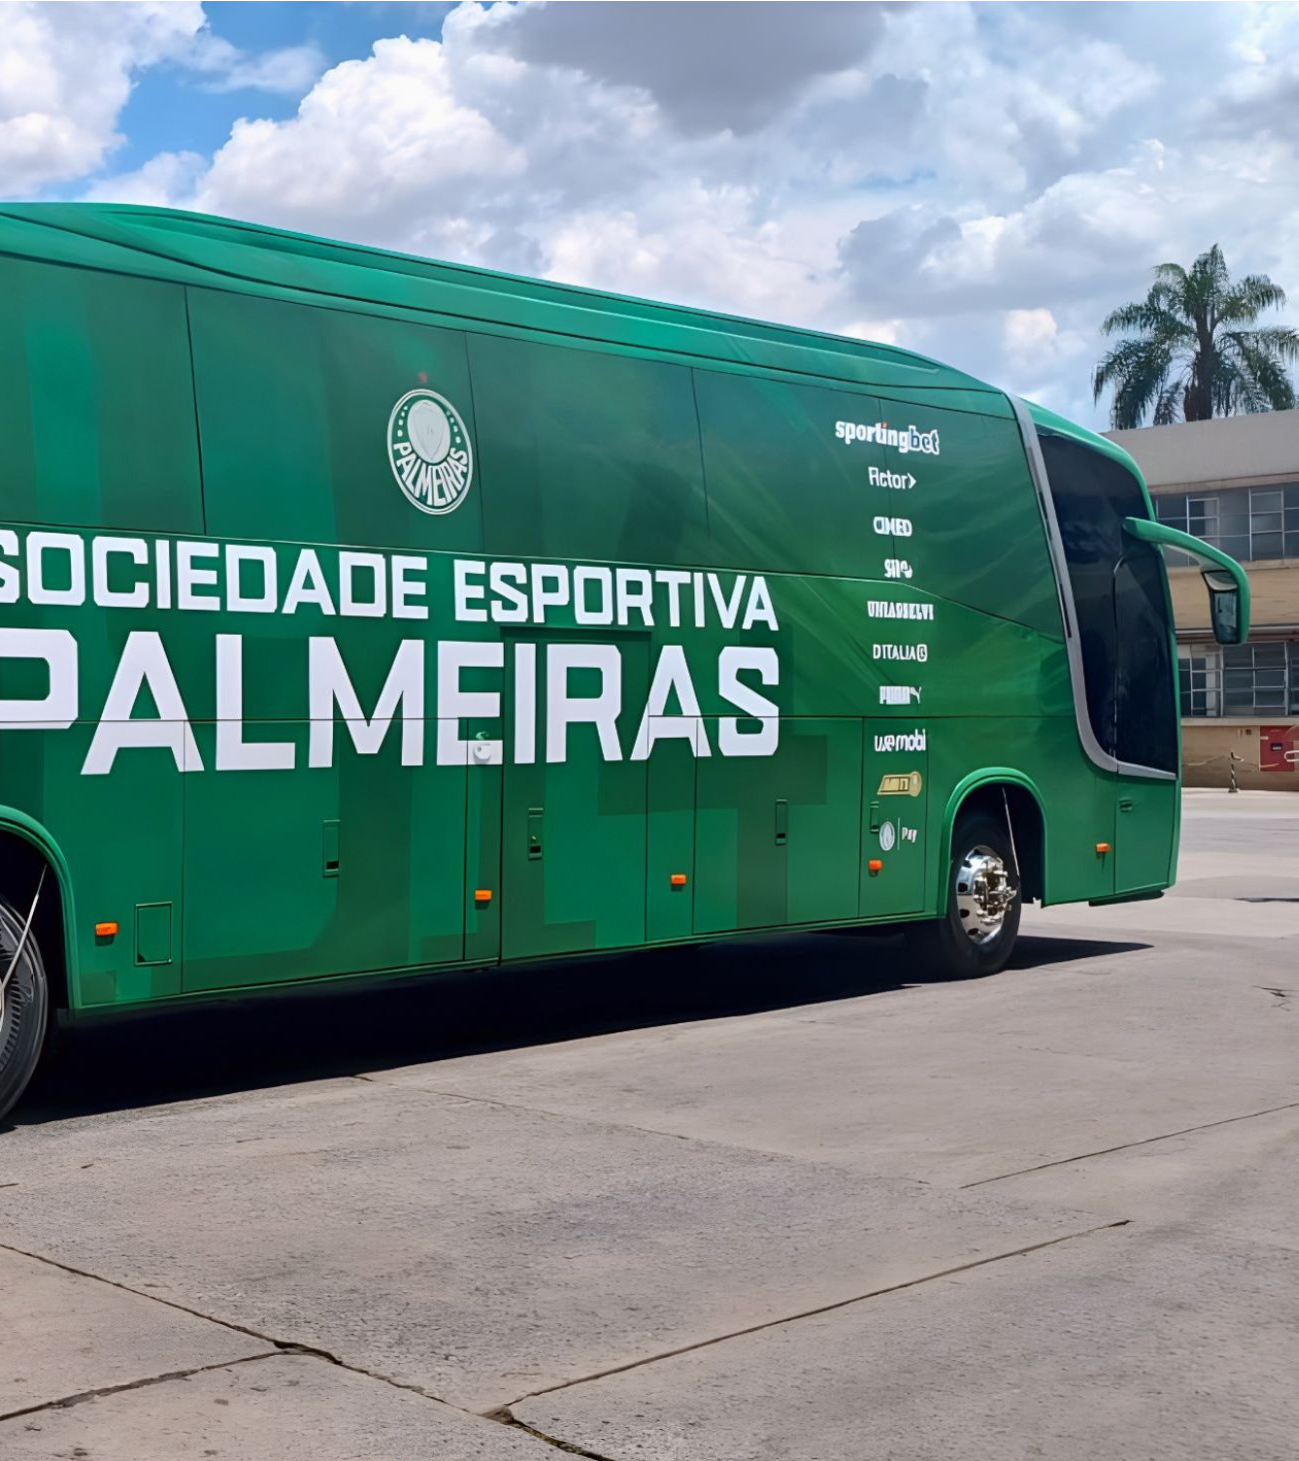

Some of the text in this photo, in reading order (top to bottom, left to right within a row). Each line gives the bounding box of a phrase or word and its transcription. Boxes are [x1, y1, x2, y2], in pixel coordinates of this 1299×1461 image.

[835, 420, 940, 456] sportingbet
[393, 442, 468, 507] PALMEIRAS
[454, 559, 779, 631] ESPORTIVA
